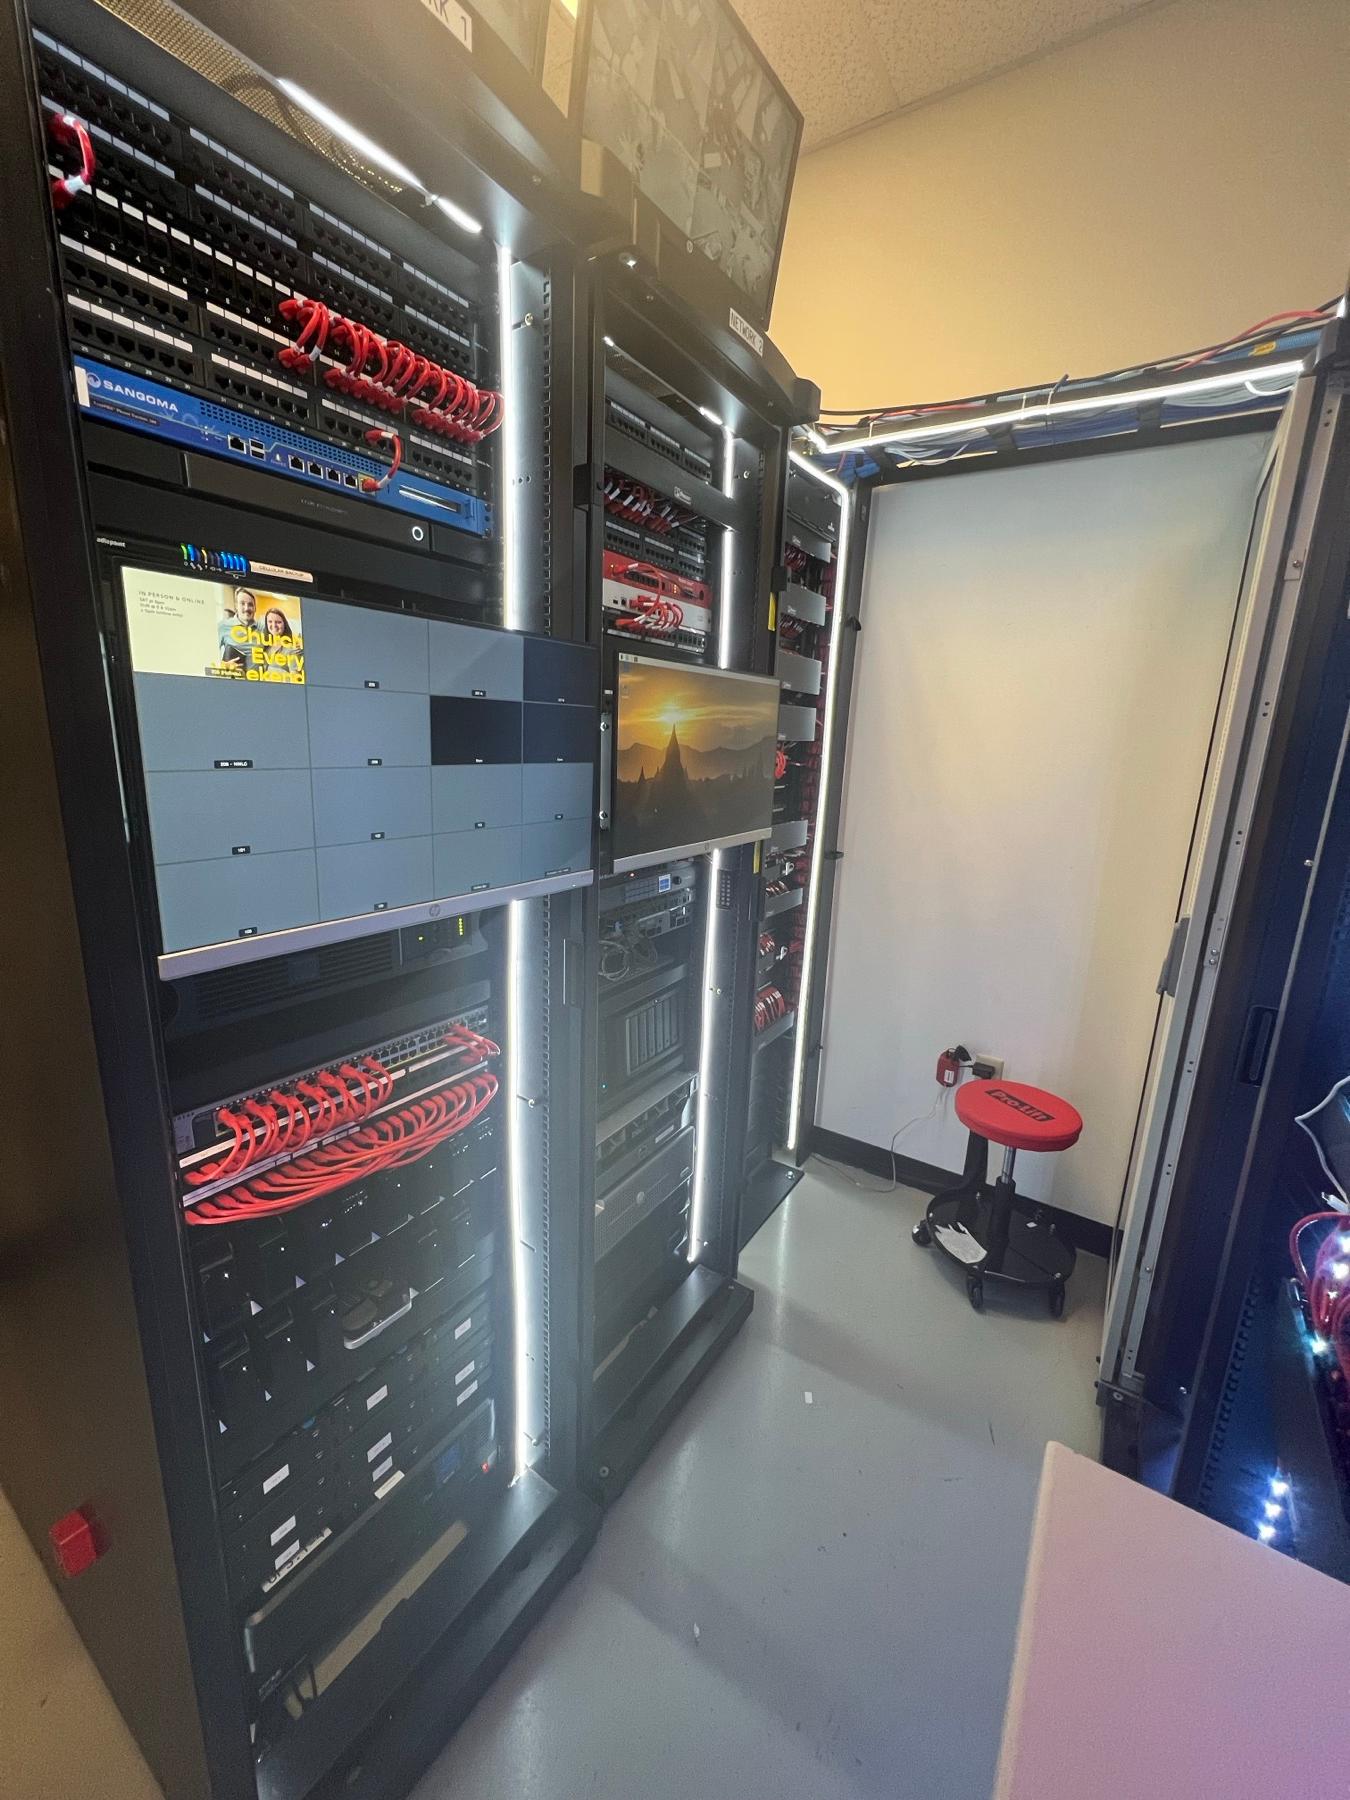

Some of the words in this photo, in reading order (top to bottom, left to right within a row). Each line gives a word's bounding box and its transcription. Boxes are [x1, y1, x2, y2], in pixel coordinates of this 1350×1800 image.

[460, 15, 467, 42] 1
[263, 316, 272, 324] 10
[730, 311, 756, 346] NETWORK
[758, 339, 763, 353] 2
[103, 379, 178, 413] SANGOMA
[147, 591, 174, 600] PERSON
[181, 596, 205, 605] ONLINE
[230, 624, 303, 650] Church
[251, 646, 305, 672] Every
